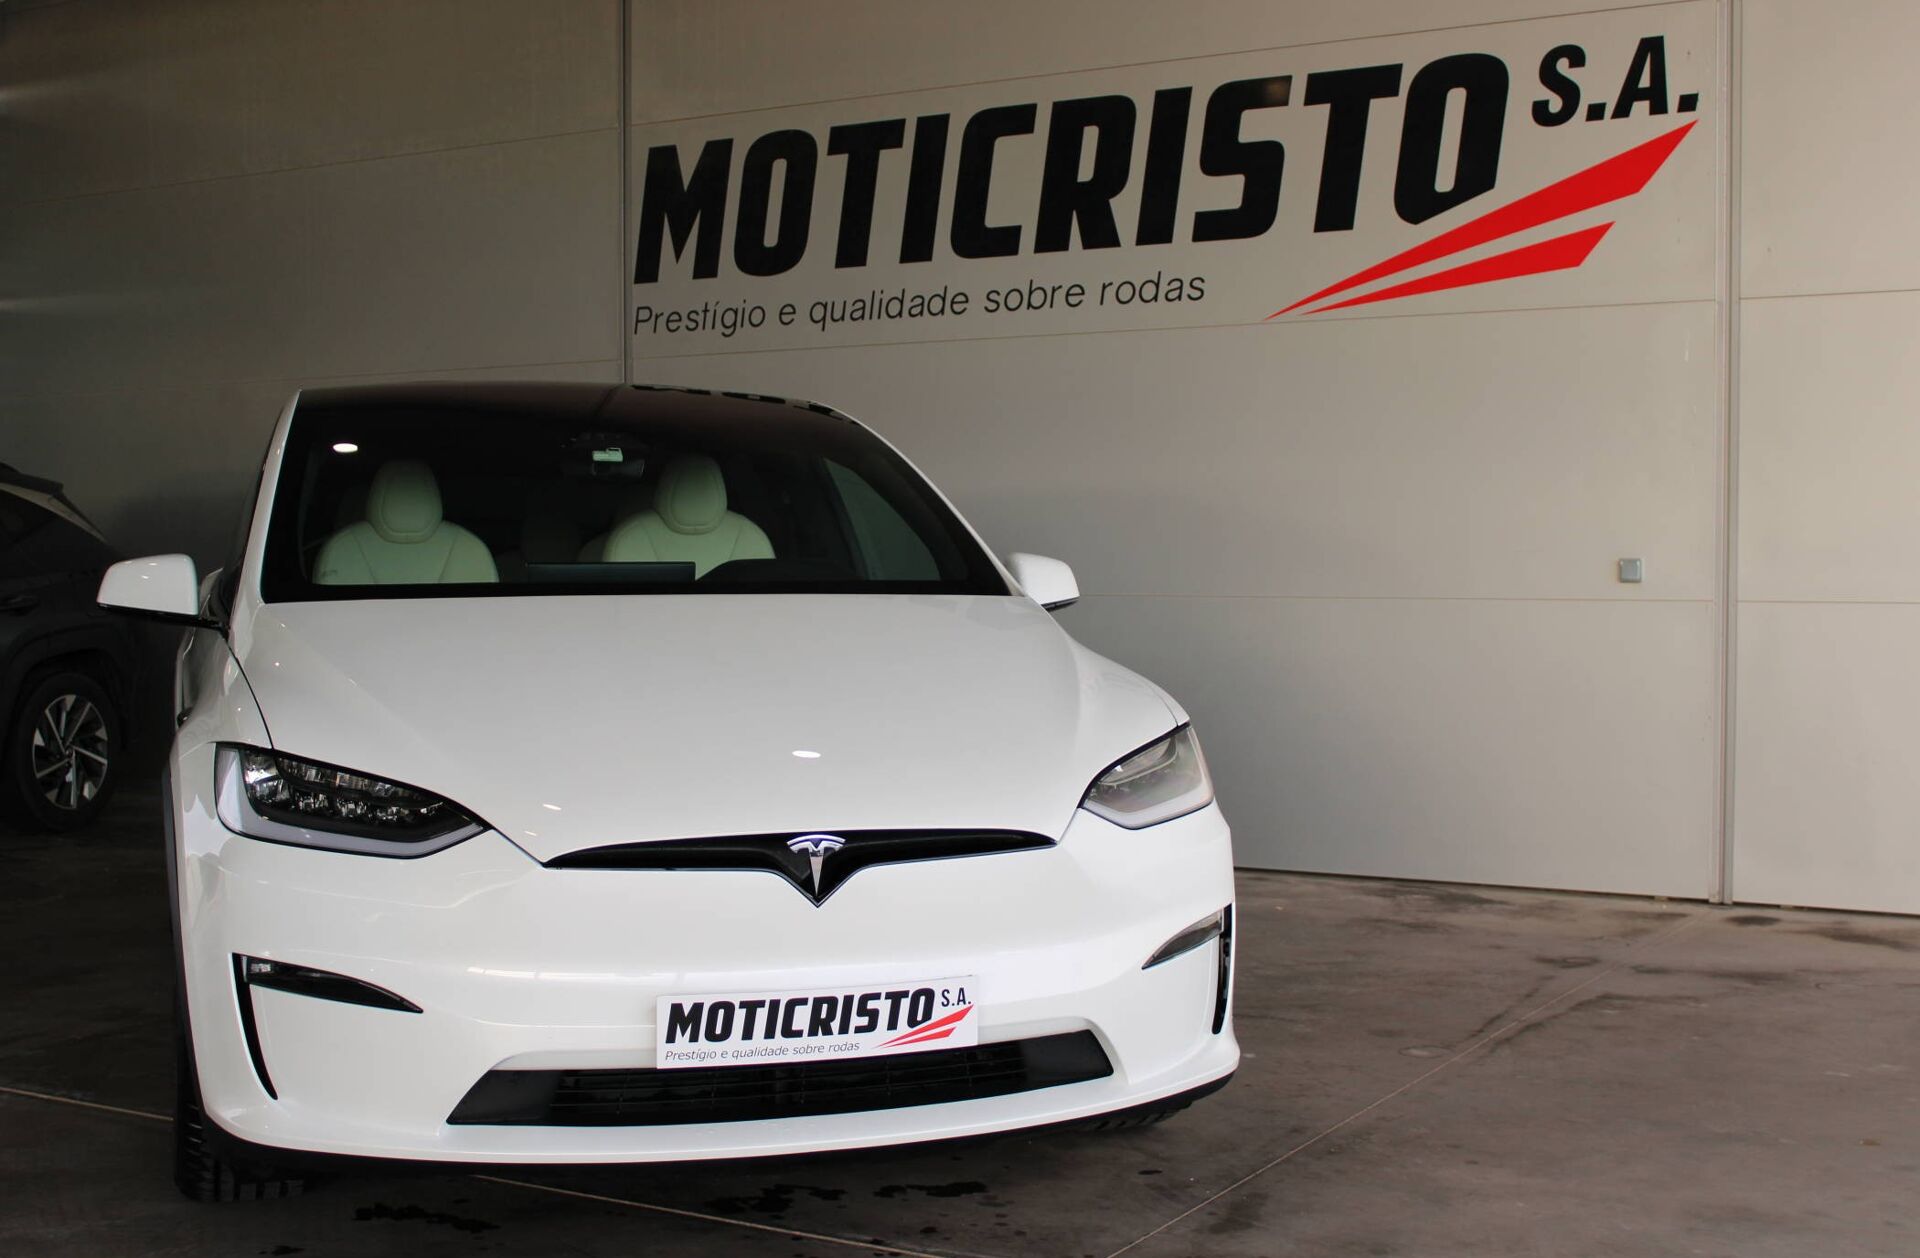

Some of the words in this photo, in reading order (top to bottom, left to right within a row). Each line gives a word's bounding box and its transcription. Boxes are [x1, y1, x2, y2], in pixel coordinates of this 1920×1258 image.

[633, 52, 1510, 285] MOTICRISTO
[1531, 35, 1700, 127] S.A.
[633, 298, 766, 337] Prestígio
[778, 302, 796, 325] e
[808, 287, 969, 331] qualidade
[983, 278, 1085, 313] sobre
[1099, 271, 1206, 305] rodas
[665, 987, 935, 1044] MOTICRISTO
[941, 987, 972, 1007] S.A.
[665, 1047, 717, 1062] Prestígio
[721, 1050, 728, 1059] e
[732, 1043, 788, 1060] qualidade
[793, 1043, 825, 1055] sobre
[828, 1040, 860, 1053] rodas
